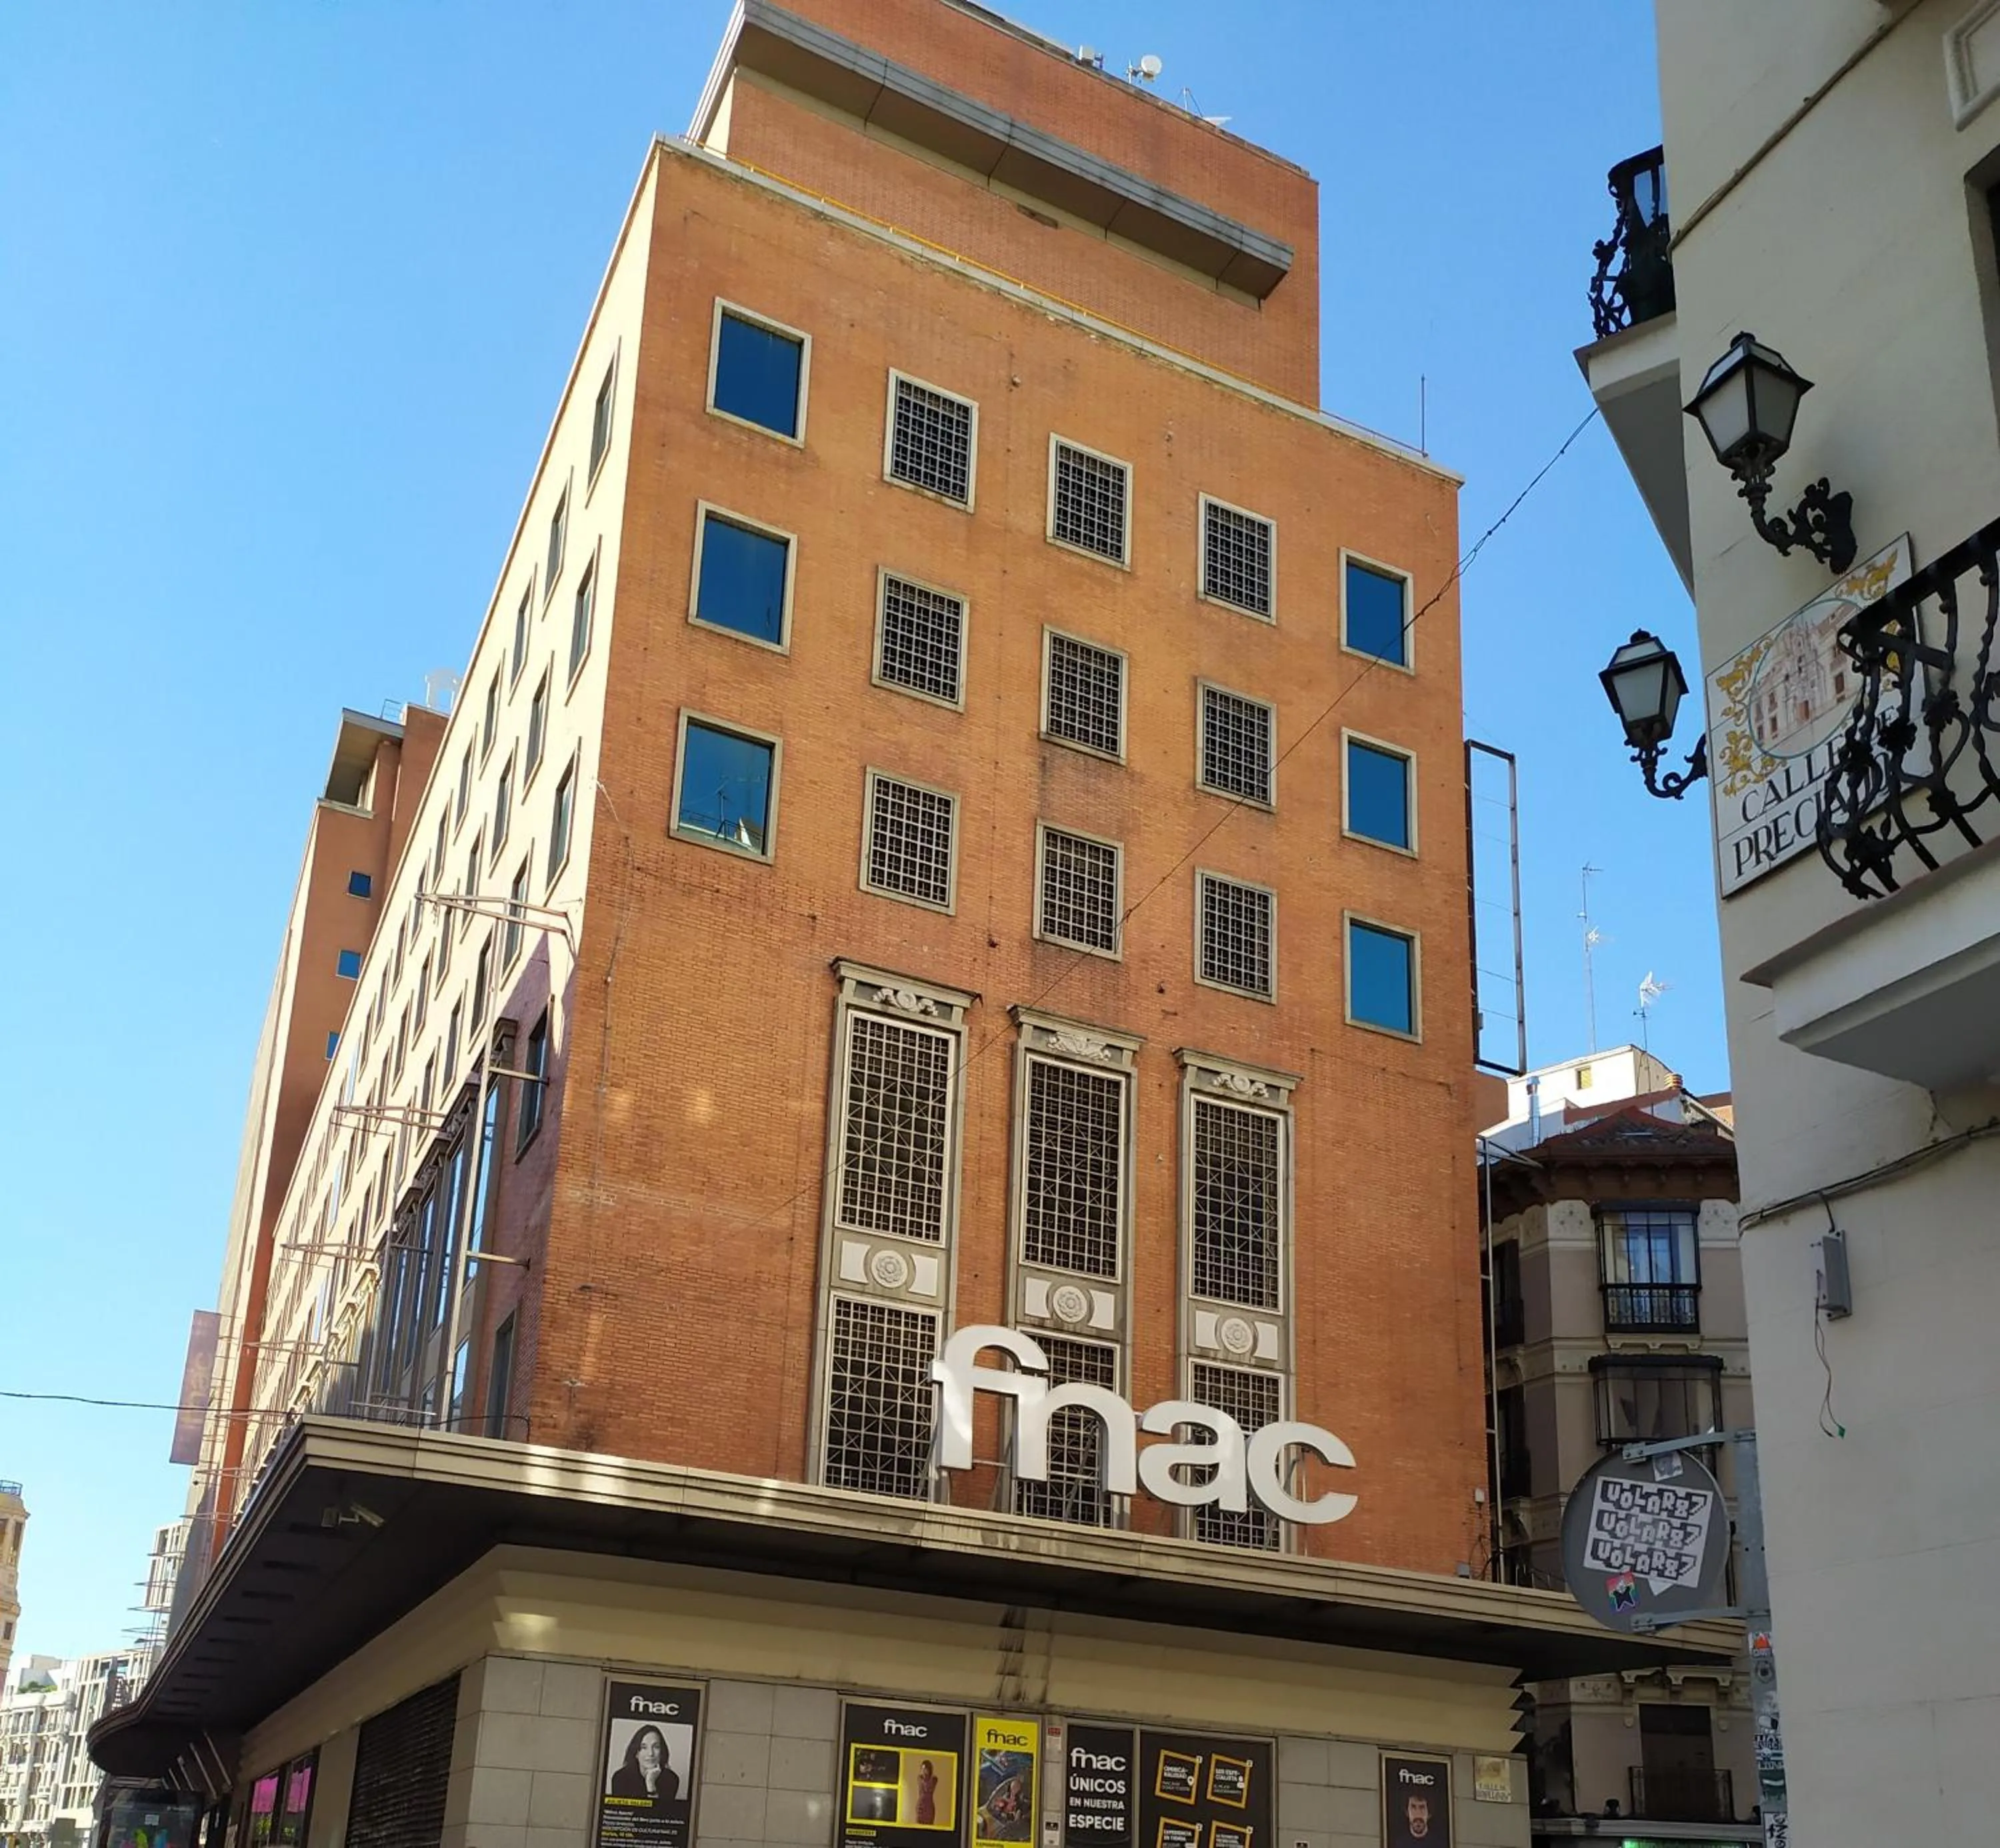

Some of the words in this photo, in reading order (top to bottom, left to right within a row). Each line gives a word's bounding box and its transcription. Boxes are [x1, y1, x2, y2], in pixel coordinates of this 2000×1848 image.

[1741, 733, 1845, 823] CALLE
[1733, 750, 1901, 879] PRECIAO
[929, 1325, 1358, 1525] fnac
[630, 1696, 679, 1716] fnac
[883, 1719, 927, 1738] fnac
[987, 1729, 1028, 1746] fnac
[1070, 1747, 1126, 1772] fnac
[1069, 1773, 1126, 1795] ÚNICOS
[1399, 1769, 1435, 1785] fnac
[1069, 1797, 1081, 1807] EN
[1083, 1798, 1125, 1811] NUESTRA
[1069, 1813, 1125, 1832] ESPECIE
